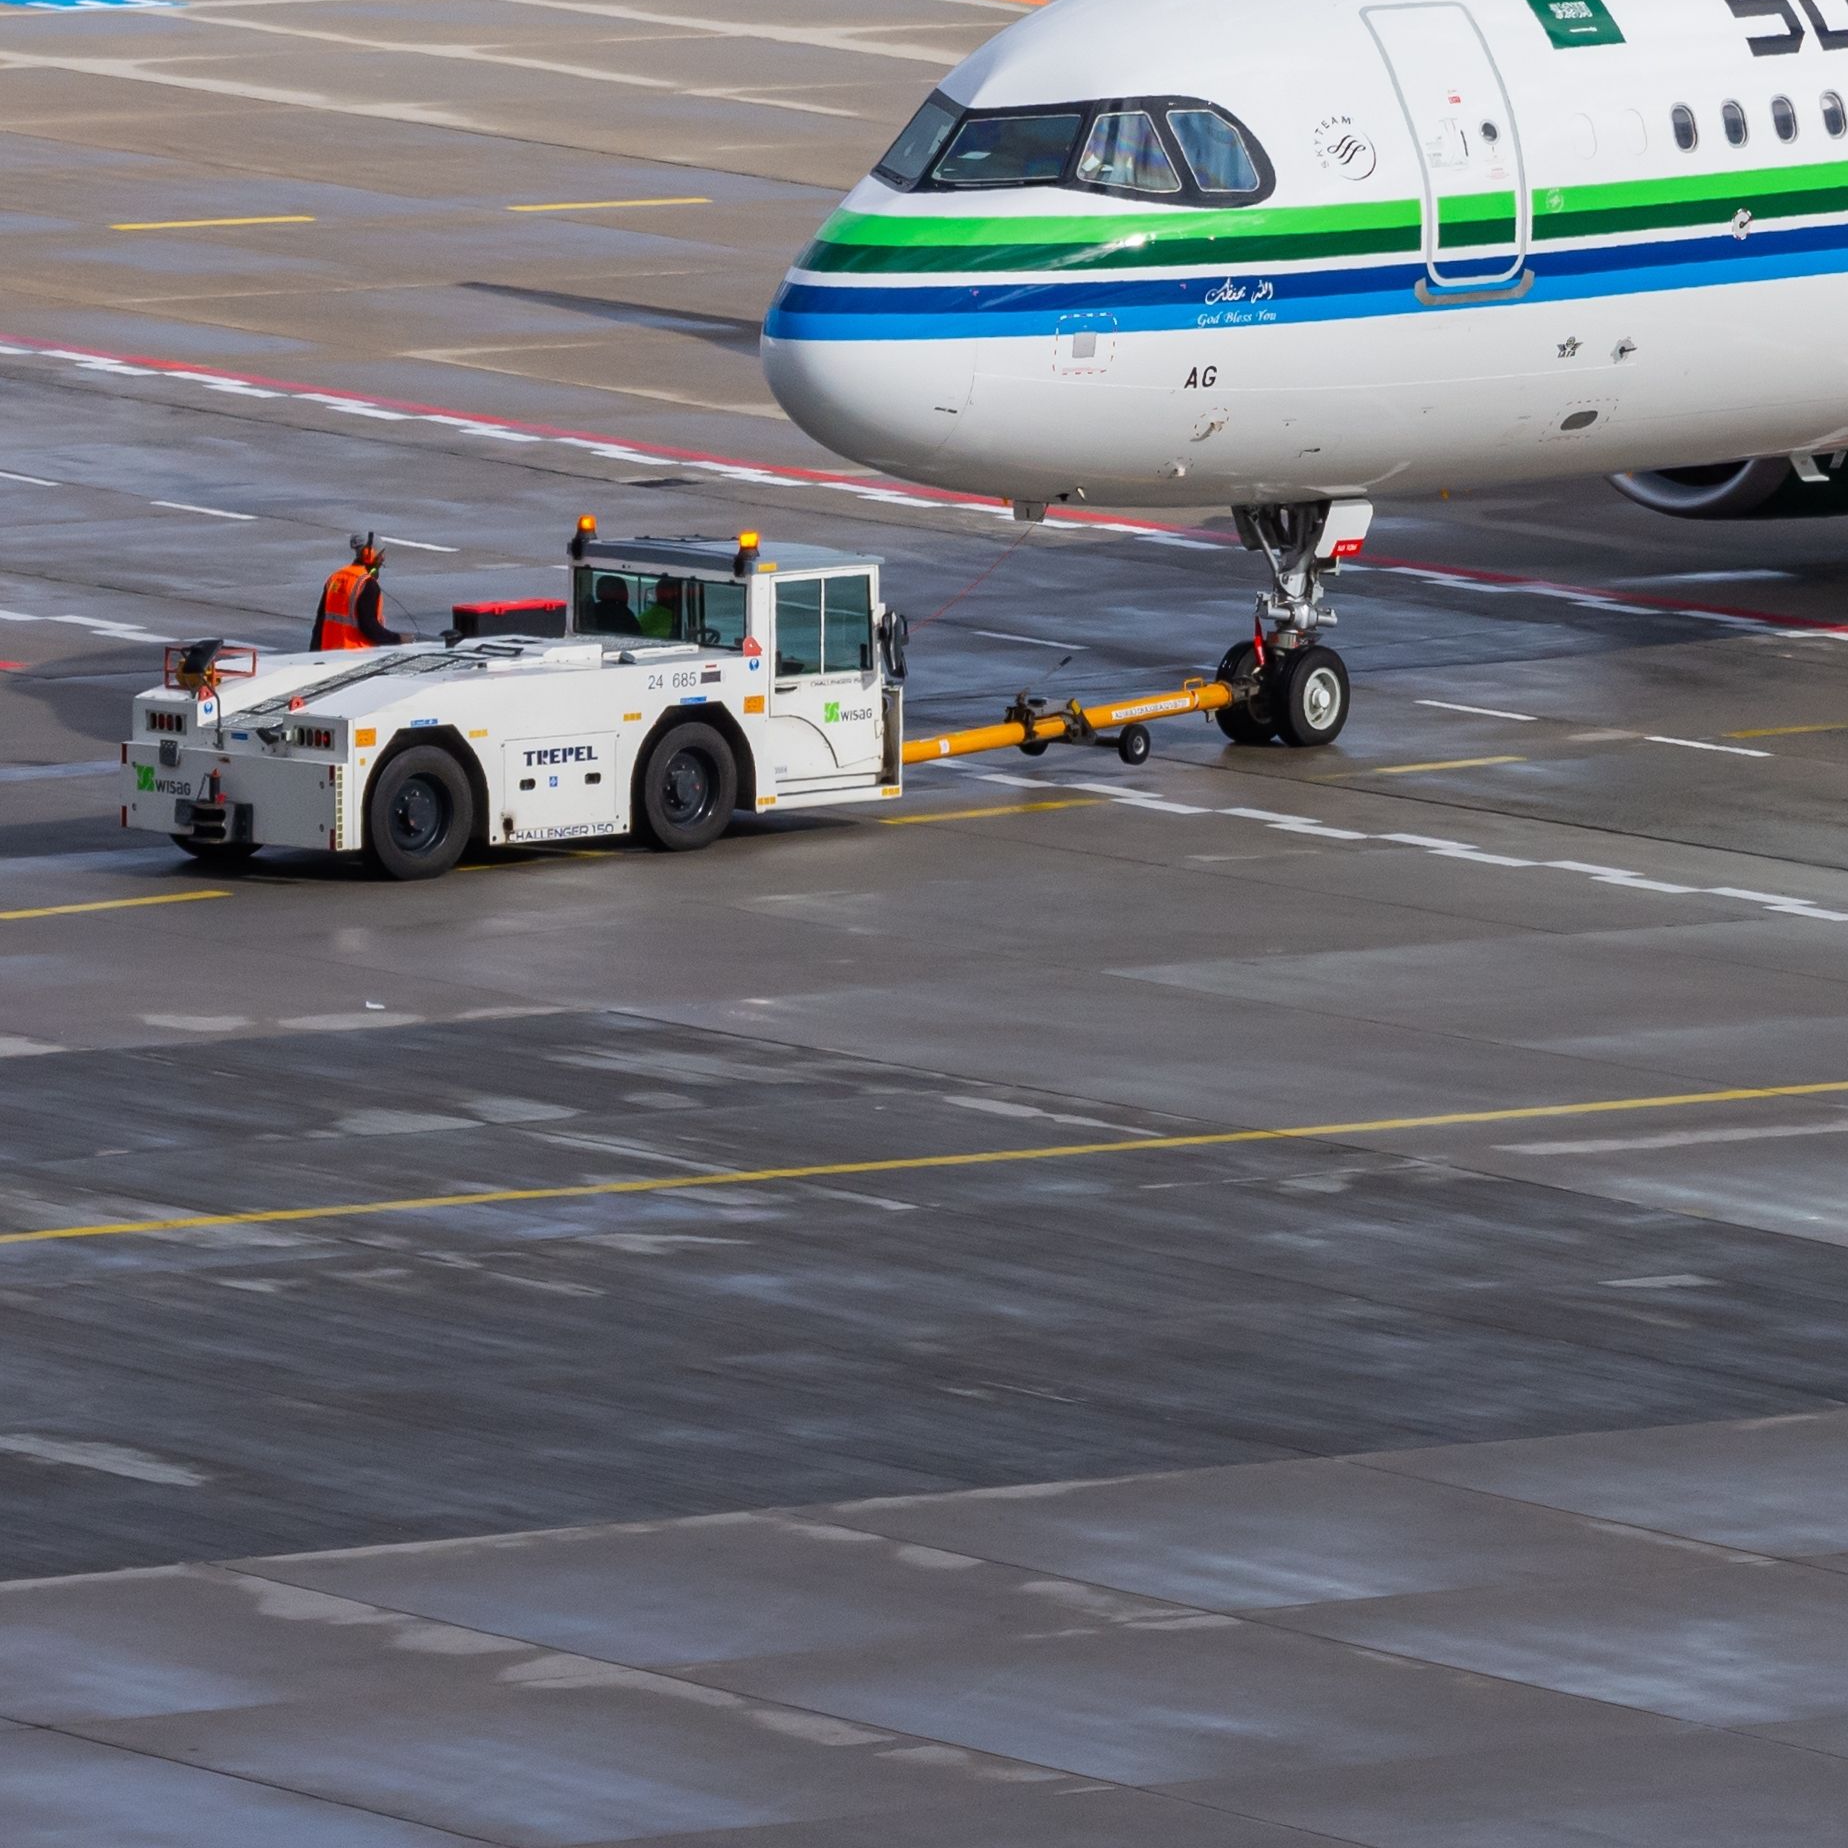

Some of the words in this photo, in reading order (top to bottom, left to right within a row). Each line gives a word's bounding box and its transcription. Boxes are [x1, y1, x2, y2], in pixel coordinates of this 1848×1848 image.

[1197, 311, 1223, 328] God
[1224, 310, 1252, 323] Bless
[1256, 309, 1277, 321] You
[1184, 365, 1218, 389] AG
[648, 675, 664, 690] 24
[672, 672, 697, 689] 685
[523, 746, 598, 767] TREPEL
